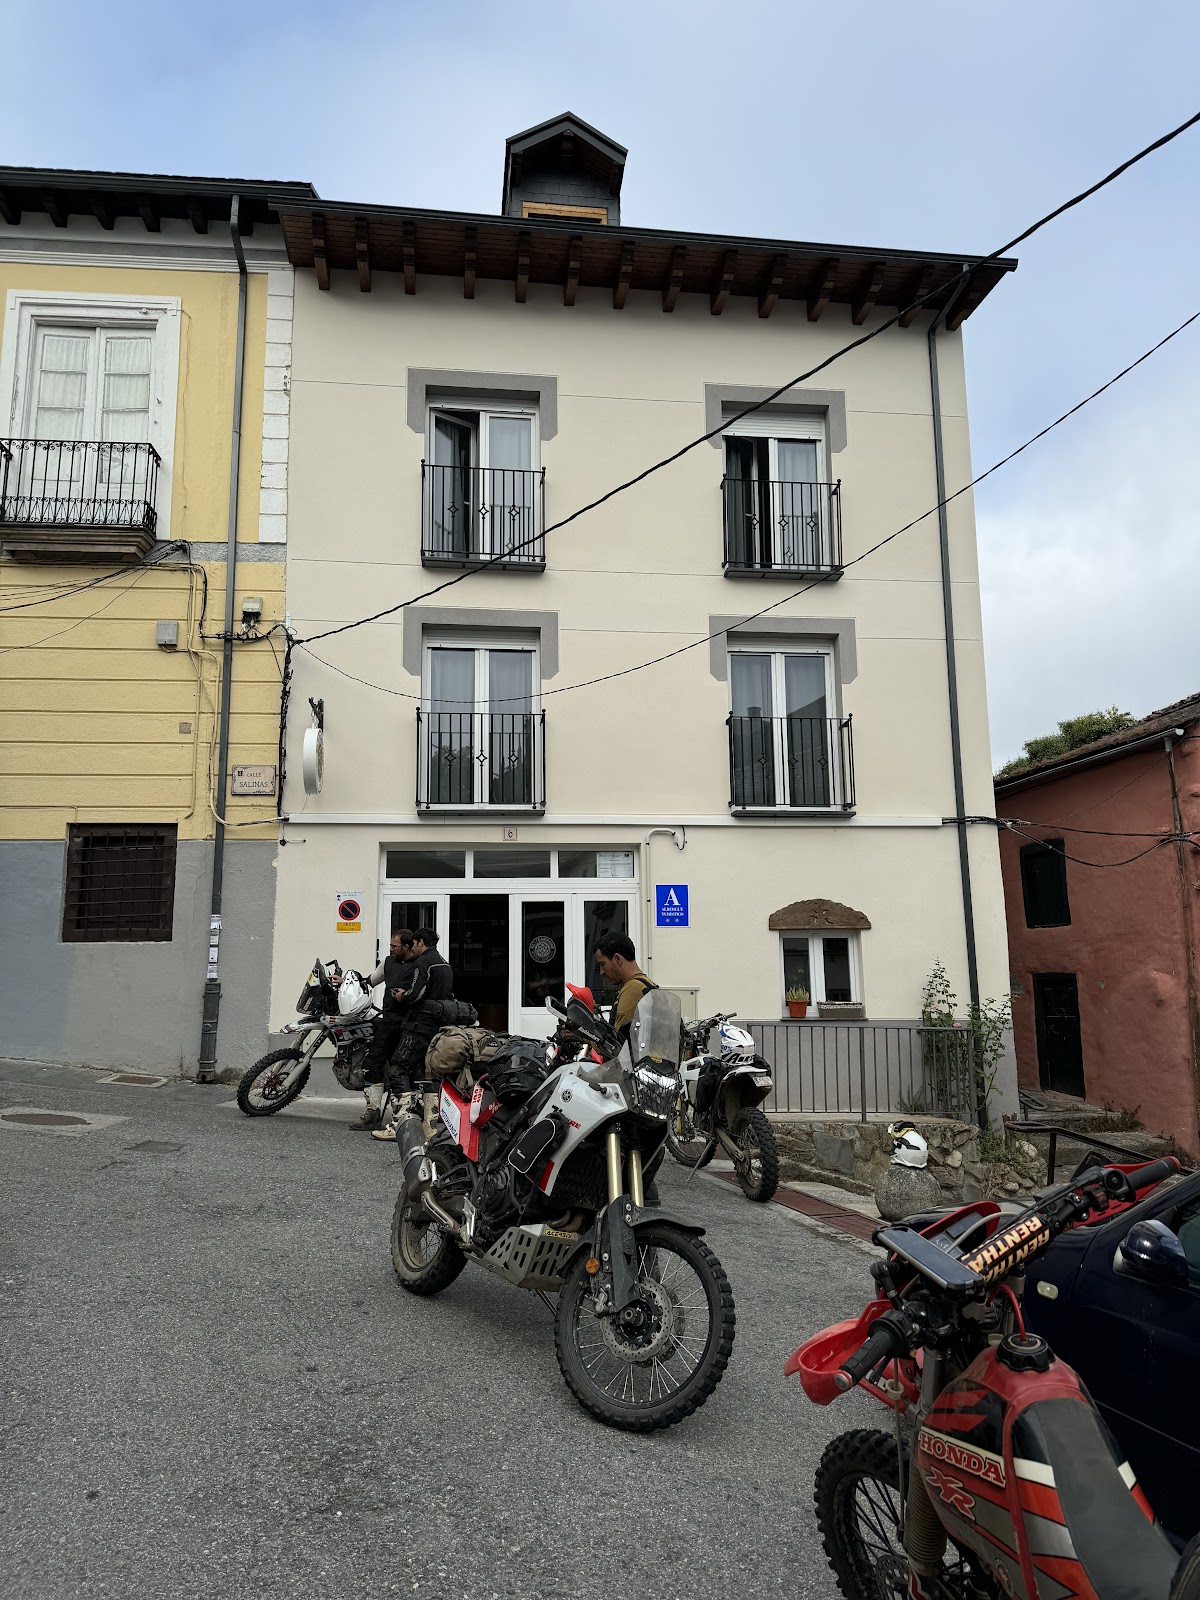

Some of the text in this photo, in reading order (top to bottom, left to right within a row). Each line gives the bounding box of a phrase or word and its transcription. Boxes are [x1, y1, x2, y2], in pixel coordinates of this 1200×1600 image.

[507, 828, 514, 839] 6
[663, 887, 681, 906] A
[965, 1216, 1043, 1274] RENTHA
[983, 1227, 1051, 1285] RENTHA
[919, 1431, 1007, 1488] HONDA
[925, 1465, 976, 1521] XR
